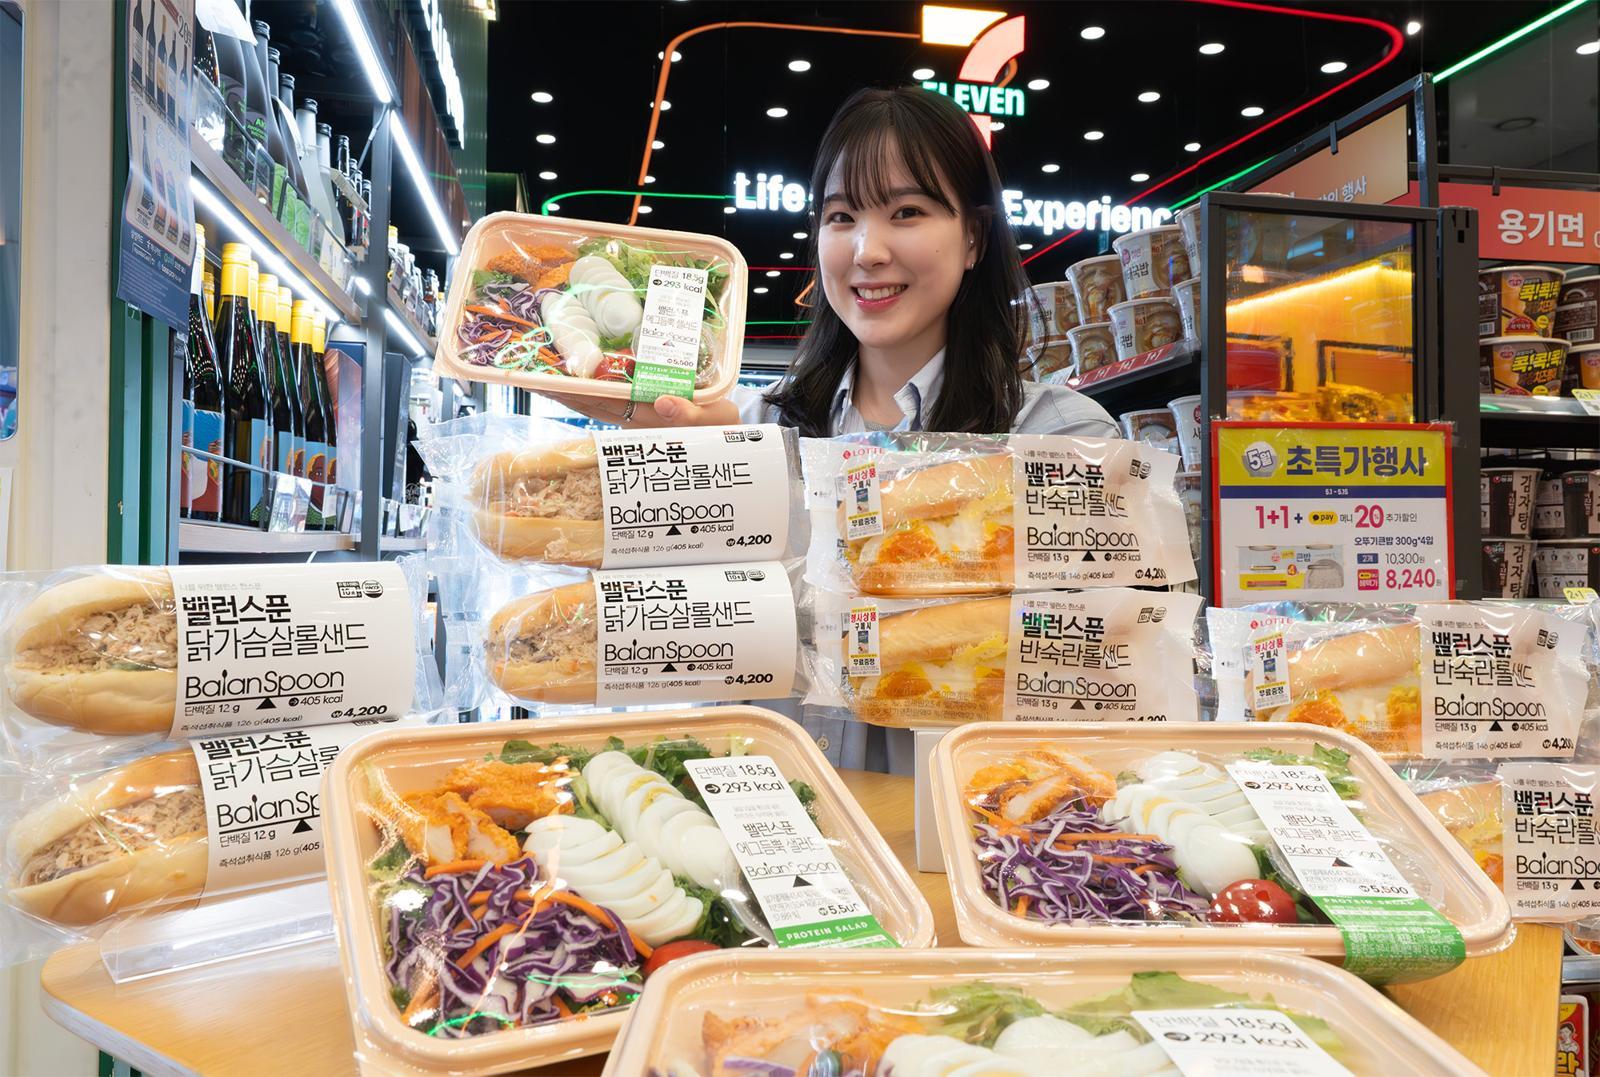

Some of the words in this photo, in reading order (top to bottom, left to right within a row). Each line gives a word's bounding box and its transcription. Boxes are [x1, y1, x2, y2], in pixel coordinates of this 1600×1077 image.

[735, 172, 806, 212] Life
[1342, 176, 1367, 202] 행사
[1002, 190, 1182, 235] Experienc
[1498, 208, 1584, 247] 용기면
[684, 283, 703, 294] kcal
[601, 441, 688, 468] 밸런스푼
[1246, 448, 1273, 472] 5월
[1286, 445, 1427, 477] 초특가행사
[606, 462, 753, 495] 닭가슴살롤샌드
[1024, 462, 1105, 488] 밸런스푼
[1518, 474, 1532, 531] 감자탕
[1256, 506, 1289, 529] 1+1
[1320, 514, 1334, 522] pay
[1340, 514, 1353, 524] 머니
[1386, 513, 1418, 523] 추가할인
[612, 530, 635, 540] 단백질
[637, 530, 646, 538] 12
[648, 531, 654, 539] g
[700, 524, 716, 533] 405
[718, 523, 734, 532] kcal
[1354, 536, 1394, 546] 오뚜기큰밥
[1028, 552, 1050, 562] 단백질
[1053, 552, 1062, 561] 13
[1063, 554, 1070, 562] g
[1112, 552, 1127, 561] 405
[600, 579, 688, 603] 밸런스푼
[182, 594, 292, 626] 밸런스푼
[604, 600, 755, 632] 닭가슴살롤샌드
[1022, 612, 1104, 642] 밸런스푼
[186, 624, 369, 662] 닭가슴살롤샌드
[1432, 632, 1512, 658] 밸런스푼
[1020, 640, 1132, 669] 반숙란롤샌드
[604, 666, 629, 676] 단백질
[642, 667, 648, 675] g
[696, 663, 714, 671] 405
[716, 662, 733, 670] kcal
[300, 696, 320, 706] 405
[322, 694, 344, 704] kcal
[1016, 697, 1040, 707] 단백질
[1042, 700, 1051, 708] 13
[1052, 700, 1058, 710] g
[1121, 702, 1136, 710] kcal
[184, 705, 216, 716] 단백질
[218, 704, 230, 713] 12
[232, 705, 240, 714] g
[1434, 723, 1458, 732] 단백질
[1460, 722, 1470, 731] 13
[1470, 724, 1477, 733] g
[1520, 722, 1534, 731] 405
[200, 730, 312, 760] 밸런스푼
[696, 765, 738, 780] 단백질
[722, 782, 752, 794] 293
[755, 780, 785, 792] kcal
[1262, 782, 1294, 791] 293
[1295, 782, 1330, 794] kcal
[1514, 790, 1594, 817] 밸런스푼
[743, 820, 798, 838] 밸런스푼
[219, 833, 251, 848] 단백질
[254, 830, 267, 840] 12
[269, 830, 276, 840] g
[736, 838, 788, 857] 에그듬뿍
[275, 848, 291, 858] 126
[1542, 882, 1552, 890] 13
[1552, 882, 1558, 891] g
[786, 927, 832, 942] PROTEIN
[835, 921, 868, 934] SALAD
[1194, 1031, 1247, 1044] 293
[1250, 1034, 1310, 1050] kcal
